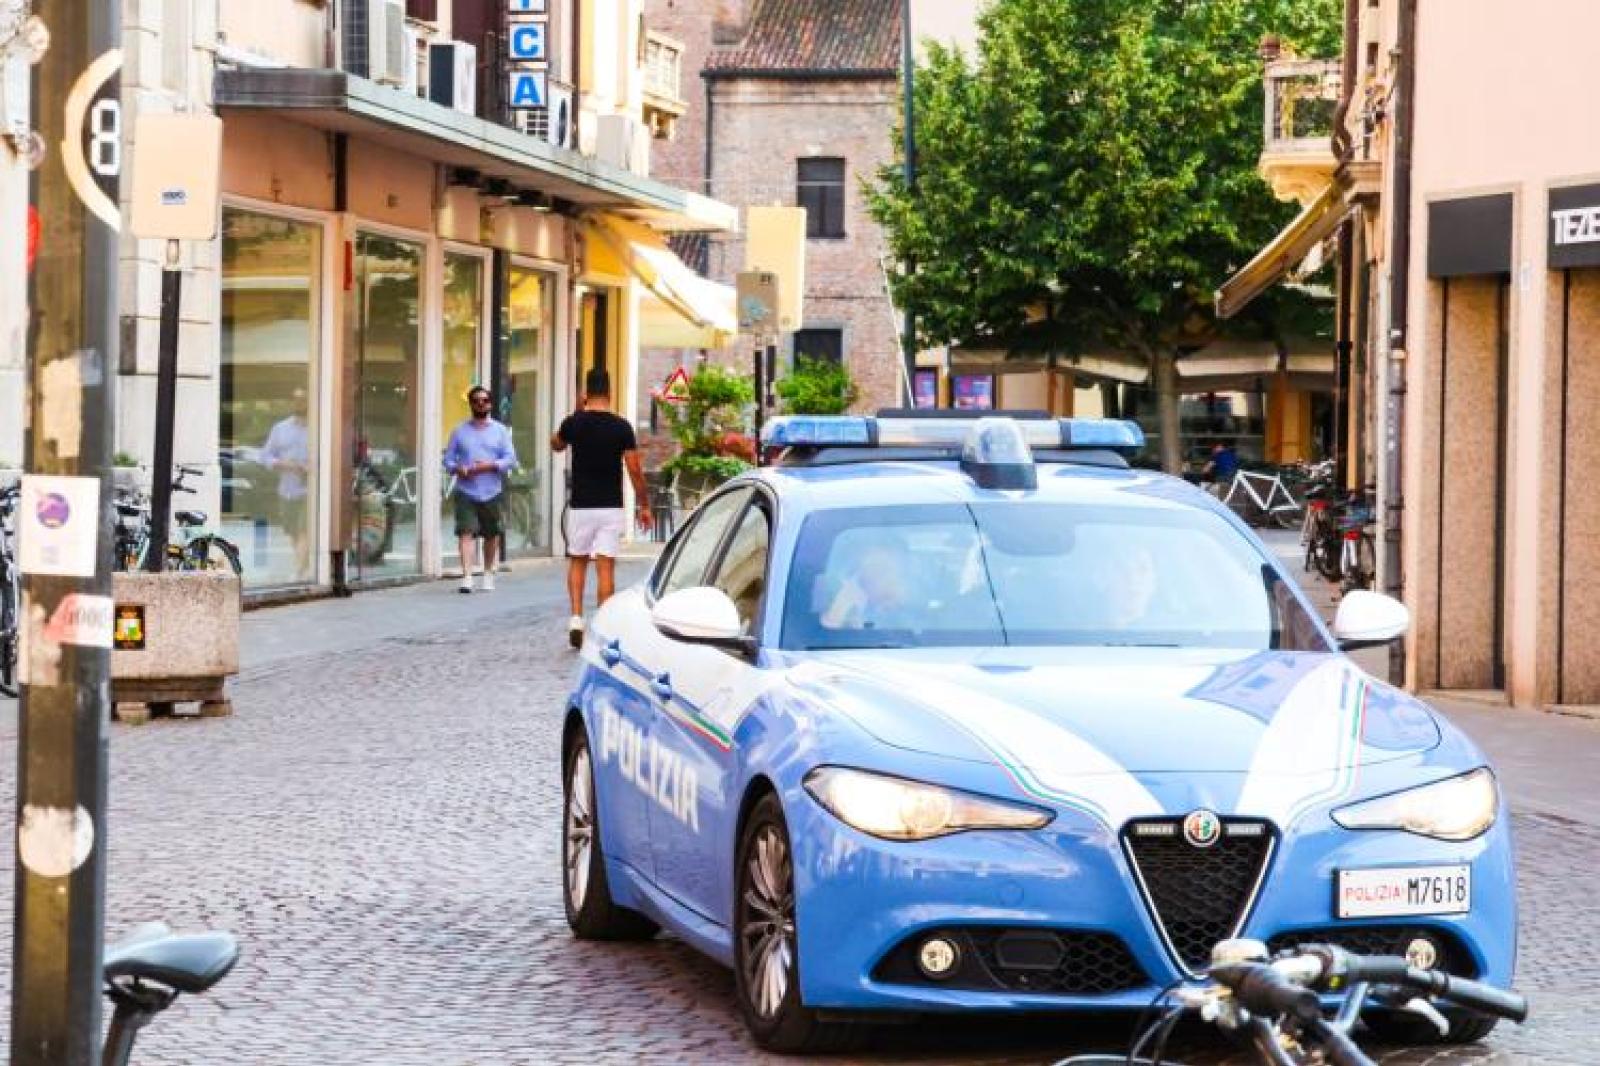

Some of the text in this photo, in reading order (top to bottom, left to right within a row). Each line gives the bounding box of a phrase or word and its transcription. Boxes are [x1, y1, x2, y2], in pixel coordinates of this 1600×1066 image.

[601, 703, 699, 833] POLIZIA
[1345, 876, 1467, 905] POLIZIA M7618
